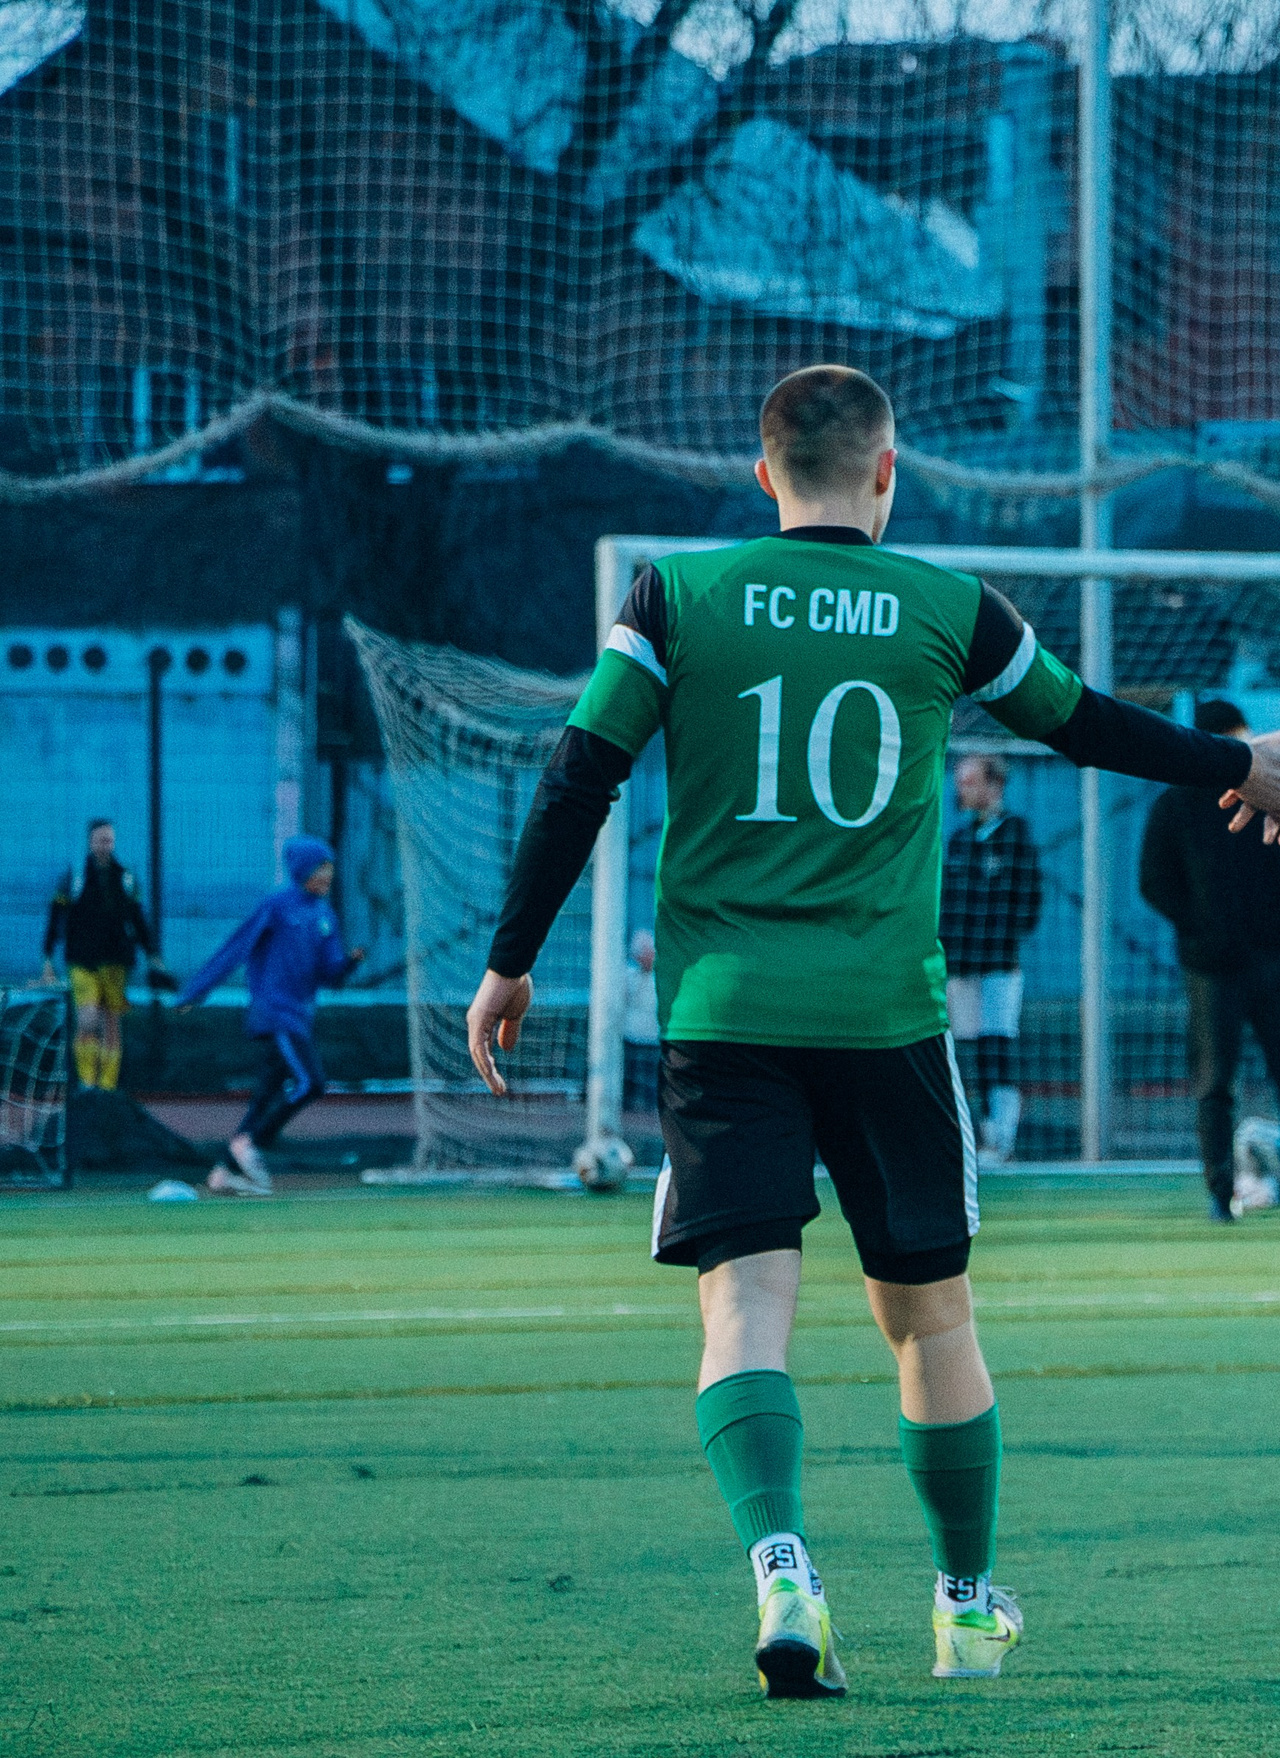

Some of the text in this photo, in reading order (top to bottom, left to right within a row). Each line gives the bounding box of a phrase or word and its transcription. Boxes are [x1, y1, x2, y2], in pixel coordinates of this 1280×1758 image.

[744, 583, 900, 637] FC CMD
[735, 674, 901, 828] 10
[759, 1543, 797, 1578] FS
